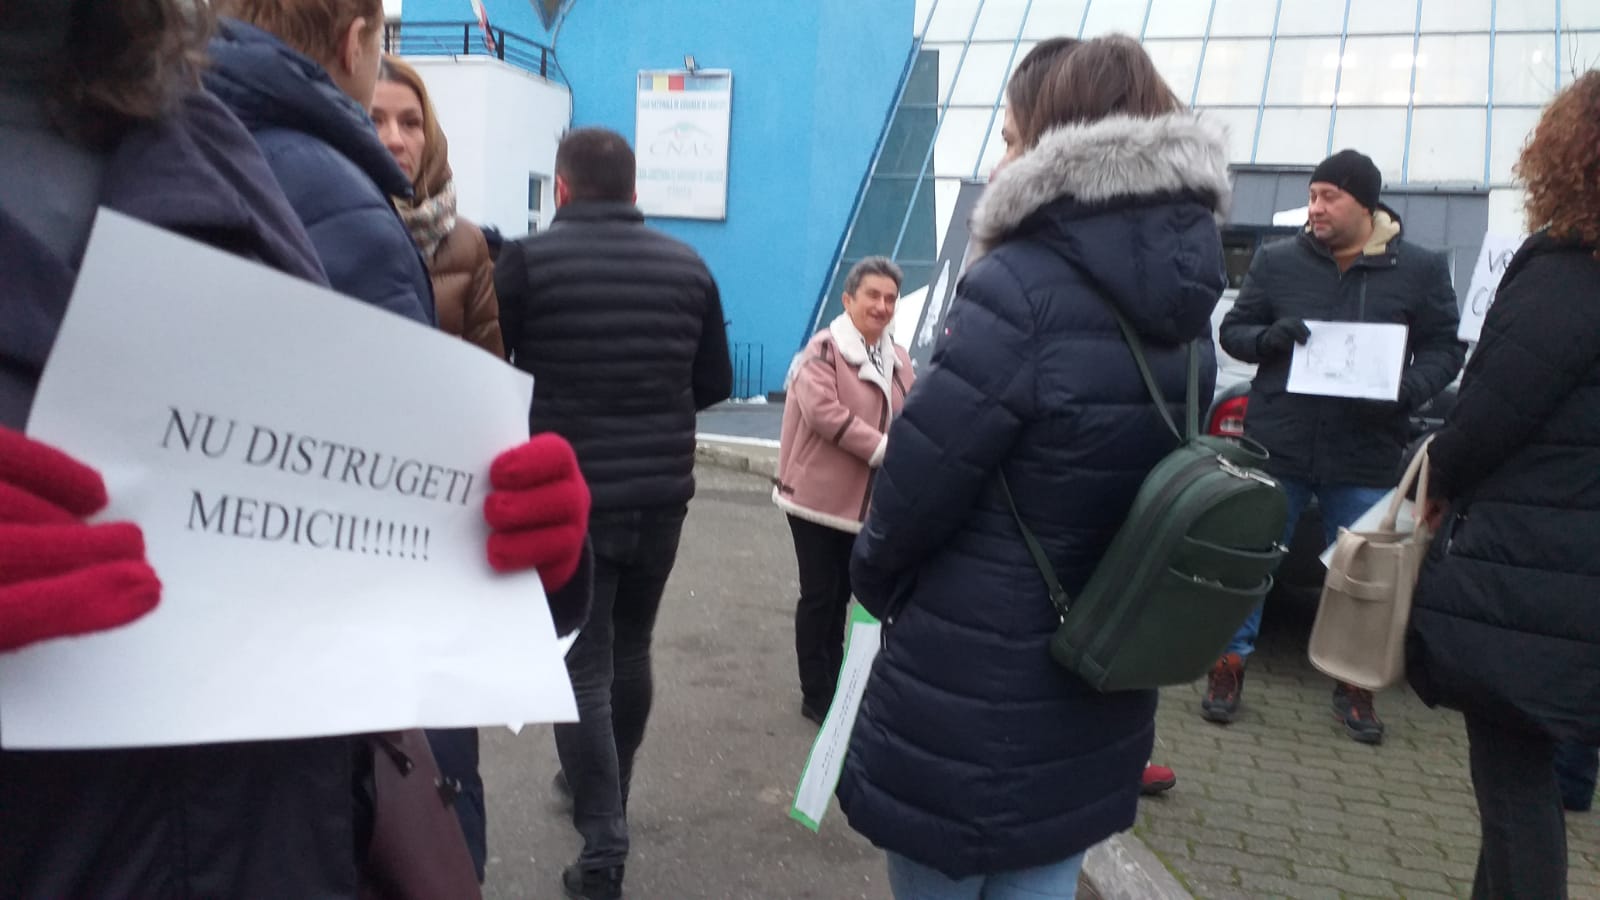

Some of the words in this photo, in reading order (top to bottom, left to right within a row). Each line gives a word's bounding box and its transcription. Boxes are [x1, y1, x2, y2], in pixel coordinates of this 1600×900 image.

[648, 141, 713, 157] CNAS
[161, 406, 237, 458] NU
[244, 425, 475, 506] DISTRUGETI
[186, 488, 431, 560] MEDICII!!!!!!
